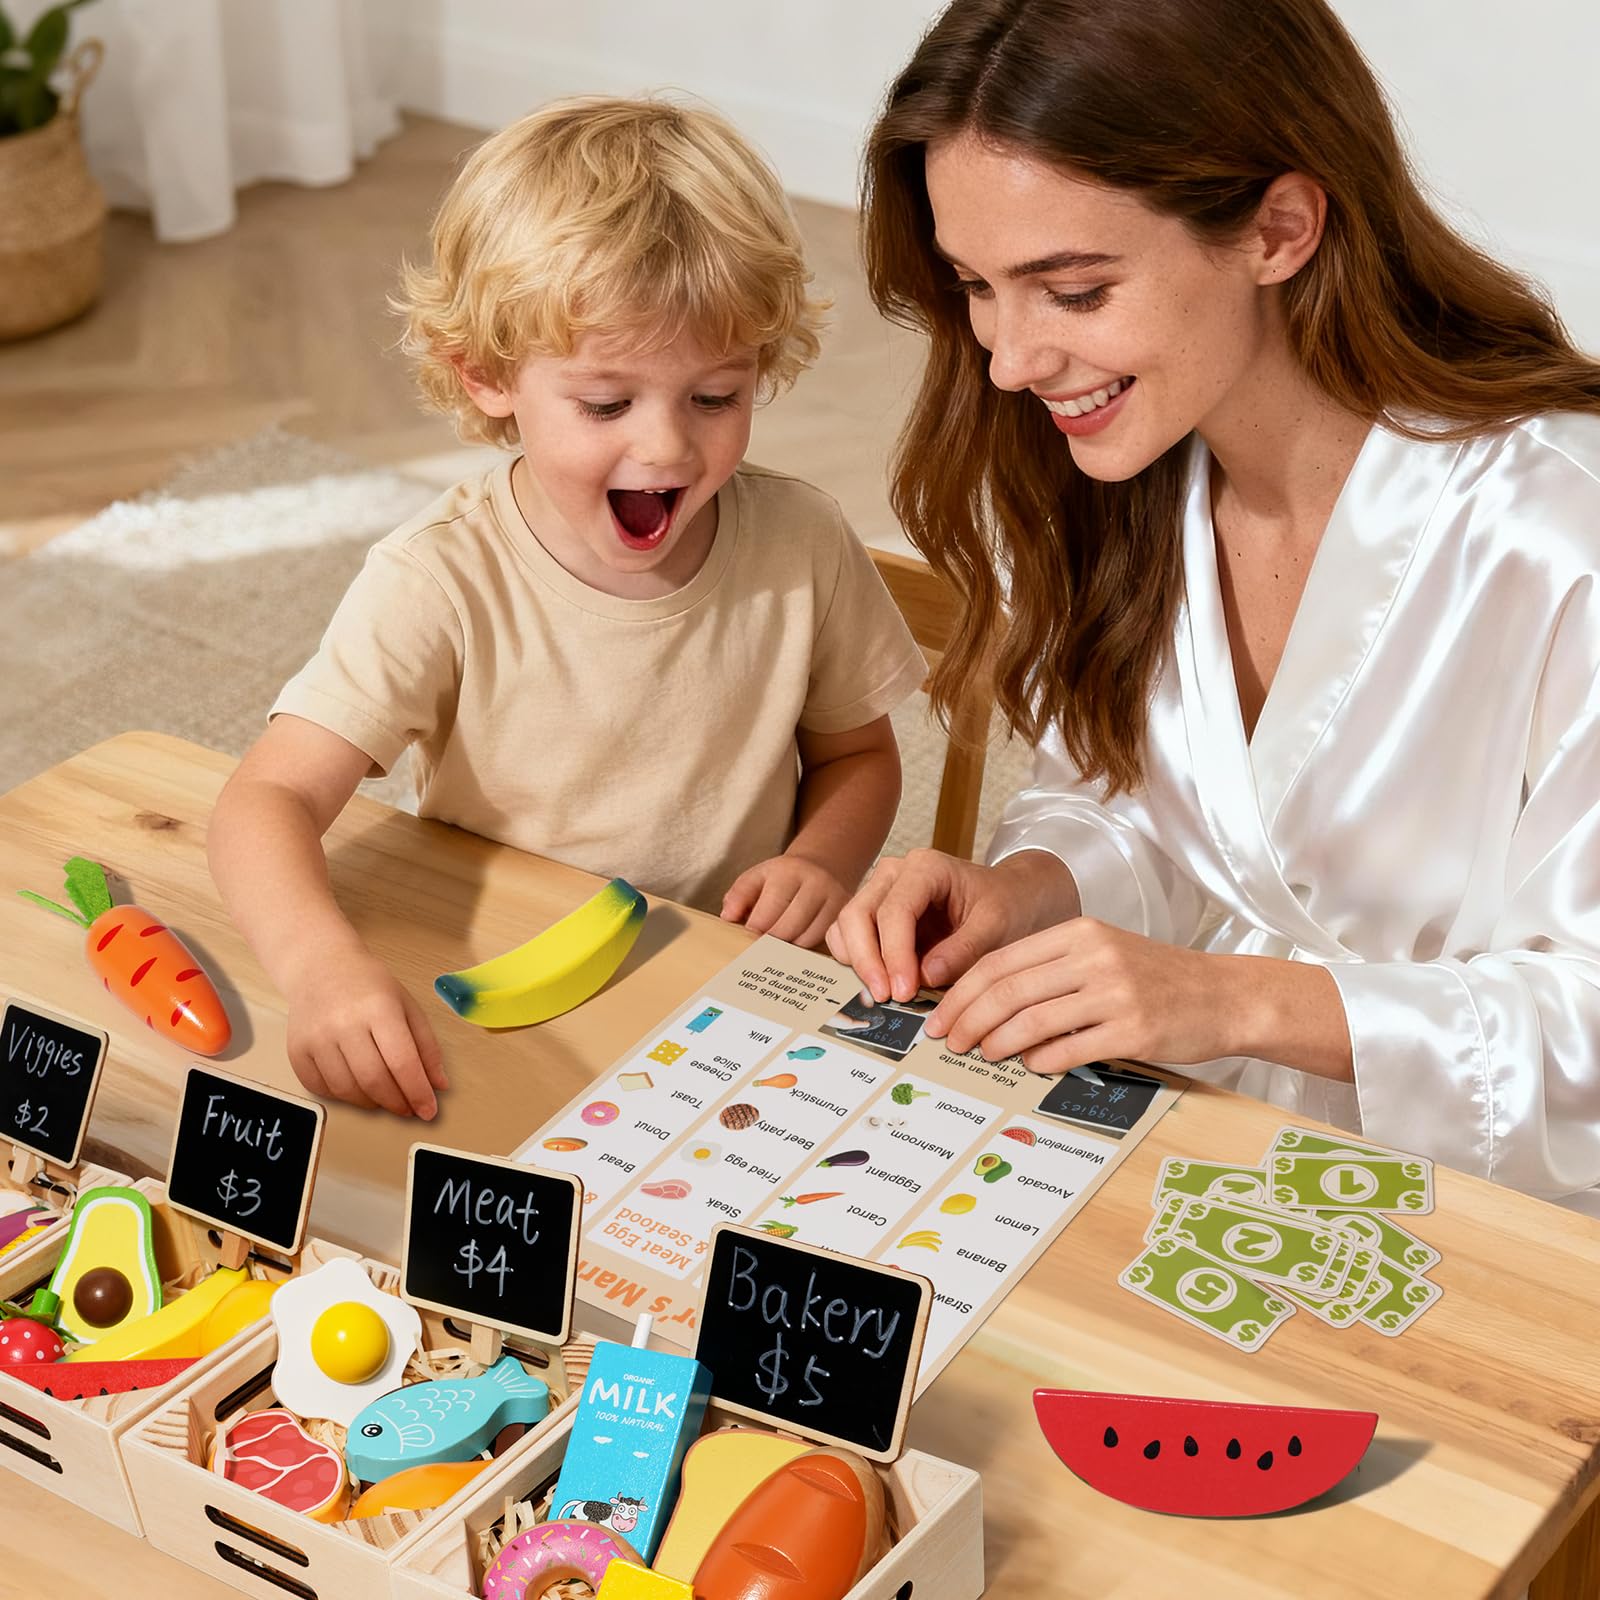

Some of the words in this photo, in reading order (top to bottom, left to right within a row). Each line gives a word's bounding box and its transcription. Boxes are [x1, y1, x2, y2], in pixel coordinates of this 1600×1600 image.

[741, 969, 766, 985] cloth
[763, 966, 783, 980] and
[786, 973, 815, 988] erase
[801, 968, 838, 985] rewrite
[738, 980, 758, 992] can
[760, 988, 781, 1003] kids
[768, 978, 797, 996] damp
[799, 990, 819, 1002] use
[818, 987, 828, 995] to
[782, 997, 807, 1012] Then
[748, 1029, 772, 1045] Milk
[8, 1023, 84, 1078] Viggies
[939, 1054, 966, 1068] write
[964, 1051, 986, 1063] sma
[690, 1060, 733, 1082] Cheese
[713, 1055, 741, 1072] Slice
[968, 1065, 990, 1076] can
[990, 1061, 1009, 1072] the
[1011, 1068, 1026, 1077] on
[850, 1068, 876, 1084] Fish
[992, 1073, 1018, 1088] Kids
[671, 1090, 703, 1109] Toast
[789, 1088, 848, 1117] Drumstick
[14, 1099, 49, 1137] $2
[935, 1101, 986, 1125] Broccoli
[202, 1095, 283, 1160] Fruit
[634, 1120, 670, 1141] Donut
[755, 1120, 786, 1137] patty
[783, 1132, 815, 1151] Beef
[890, 1129, 955, 1160] Mushroom
[1037, 1136, 1105, 1165] Watermelon
[598, 1152, 636, 1173] Bread
[725, 1153, 748, 1168] egg
[747, 1165, 782, 1184] Fried
[865, 1166, 922, 1193] Eggplant
[216, 1169, 261, 1216] $3
[1017, 1175, 1075, 1199] Avocado
[433, 1178, 540, 1245] Meat
[705, 1197, 742, 1218] Steak
[846, 1205, 887, 1226] Carrot
[603, 1222, 642, 1248] Egg
[615, 1207, 693, 1247] Seafood
[995, 1214, 1040, 1236] Lemon
[694, 1240, 709, 1254] &
[1233, 1227, 1273, 1258] 2
[641, 1241, 693, 1271] Meat
[956, 1248, 1008, 1273] Banana
[453, 1238, 514, 1297] $4
[1185, 1273, 1229, 1306] 5
[728, 1247, 900, 1358] Bakery
[934, 1291, 973, 1314] Straw
[623, 1373, 656, 1386] ORGANIC
[756, 1333, 830, 1406] $5
[588, 1377, 677, 1419] MILK
[595, 1411, 618, 1424] 100%
[620, 1417, 665, 1432] NATURAL
